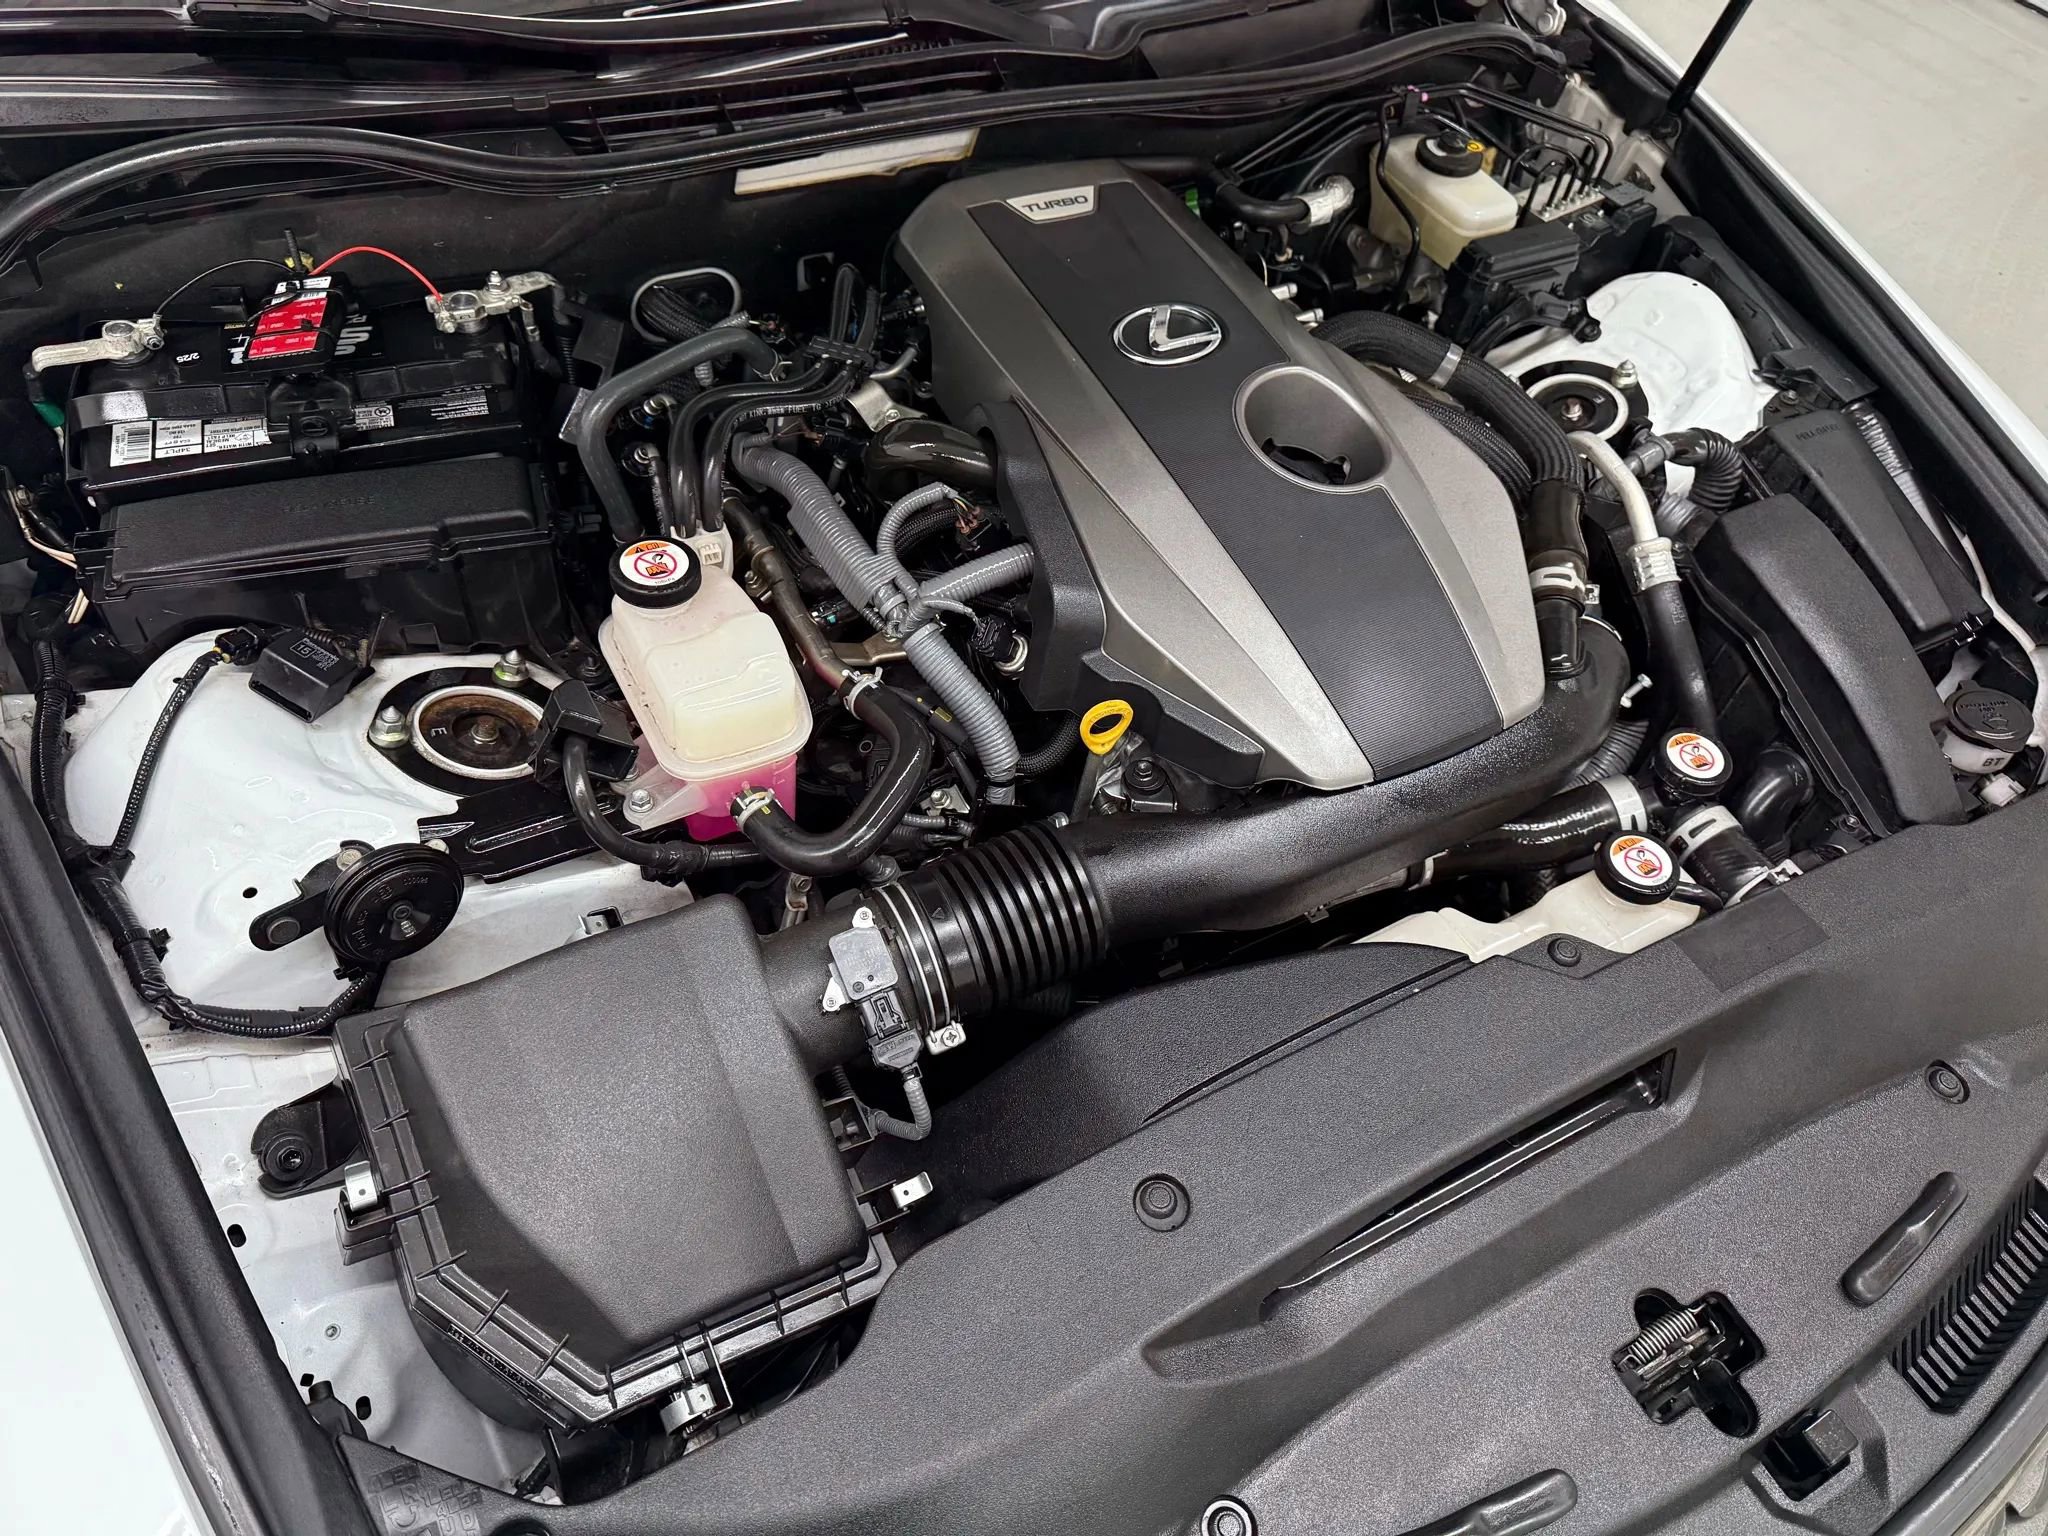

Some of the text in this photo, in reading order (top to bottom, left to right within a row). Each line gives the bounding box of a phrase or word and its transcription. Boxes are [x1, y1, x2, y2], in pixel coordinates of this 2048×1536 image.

[1022, 195, 1088, 212] TURBO
[176, 352, 200, 363] 2/25
[297, 644, 311, 654] 15
